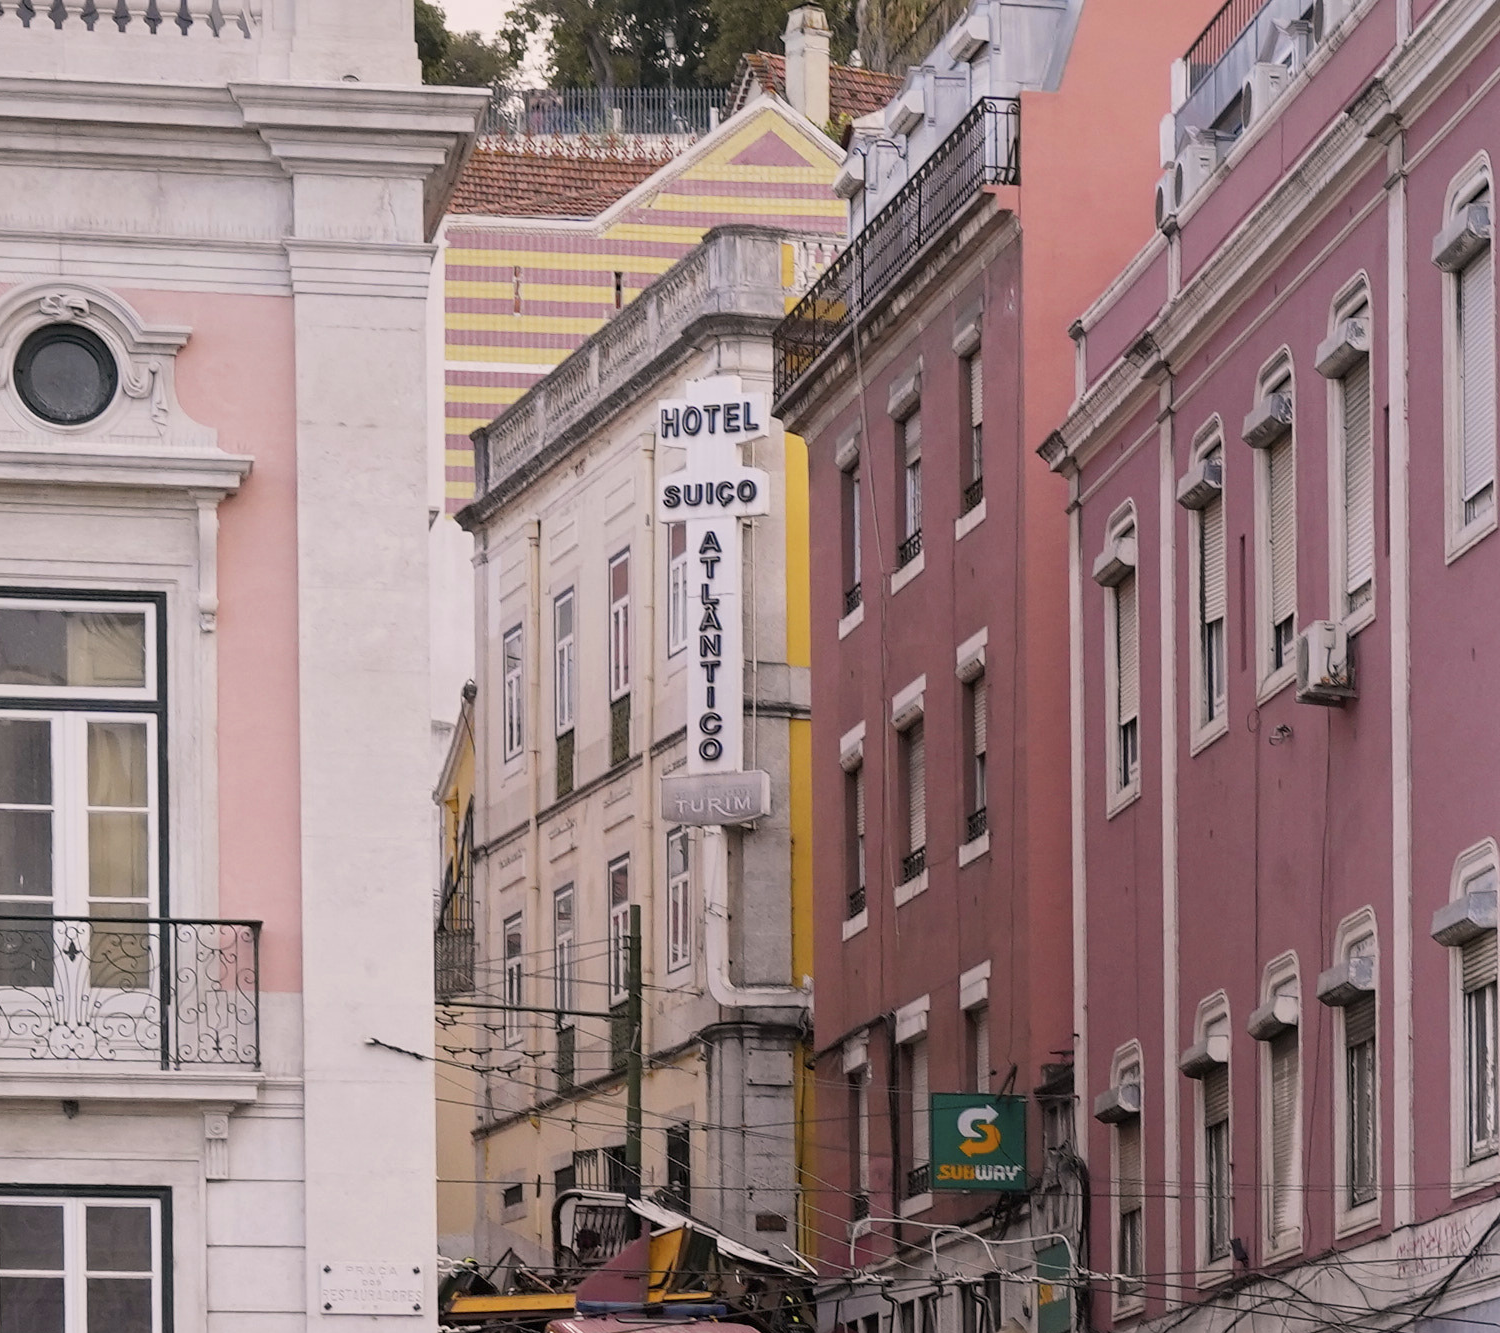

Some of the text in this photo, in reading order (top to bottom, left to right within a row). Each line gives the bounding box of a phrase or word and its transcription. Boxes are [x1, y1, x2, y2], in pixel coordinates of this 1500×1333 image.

[660, 401, 759, 439] HOTEL
[663, 478, 758, 509] SUIÇO
[699, 530, 723, 761] ATLÂNTICO
[675, 795, 752, 816] TURIM
[936, 1164, 1025, 1182] SUBWAY
